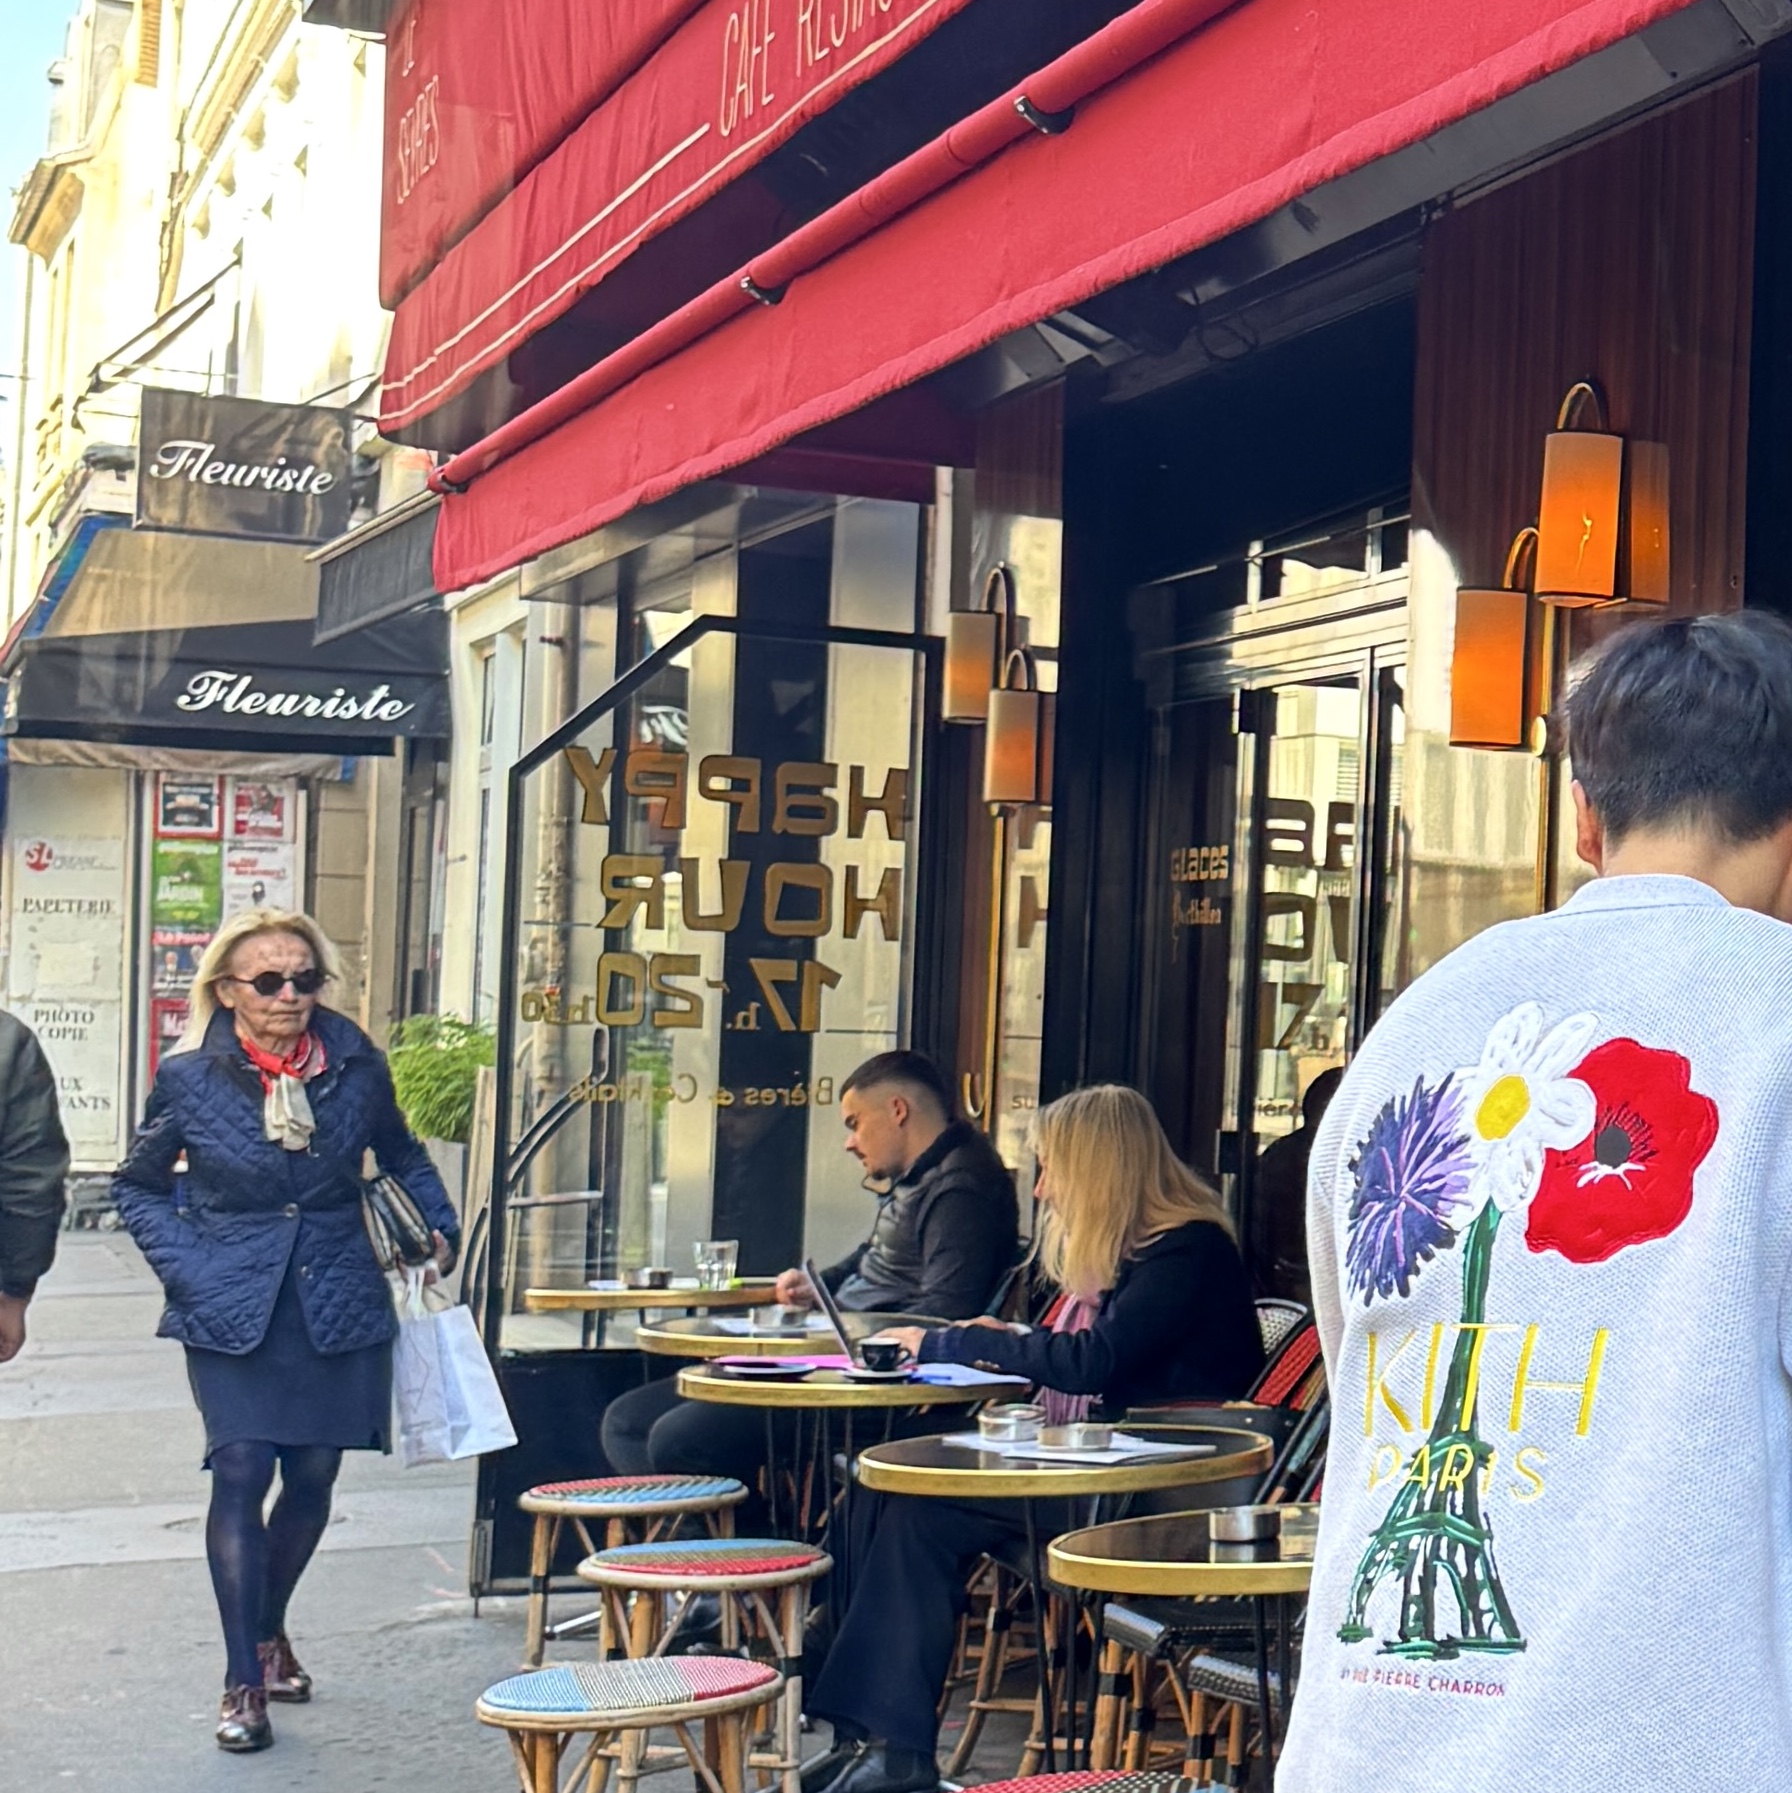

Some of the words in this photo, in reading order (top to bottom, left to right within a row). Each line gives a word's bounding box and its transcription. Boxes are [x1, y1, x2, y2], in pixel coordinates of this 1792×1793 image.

[150, 440, 339, 495] Fleuriste
[177, 670, 415, 721] Fleuriste
[34, 1009, 95, 1024] PHOTO
[38, 1026, 88, 1041] COPIE
[1363, 1321, 1611, 1438] KITH
[1367, 1443, 1549, 1501] PARIS
